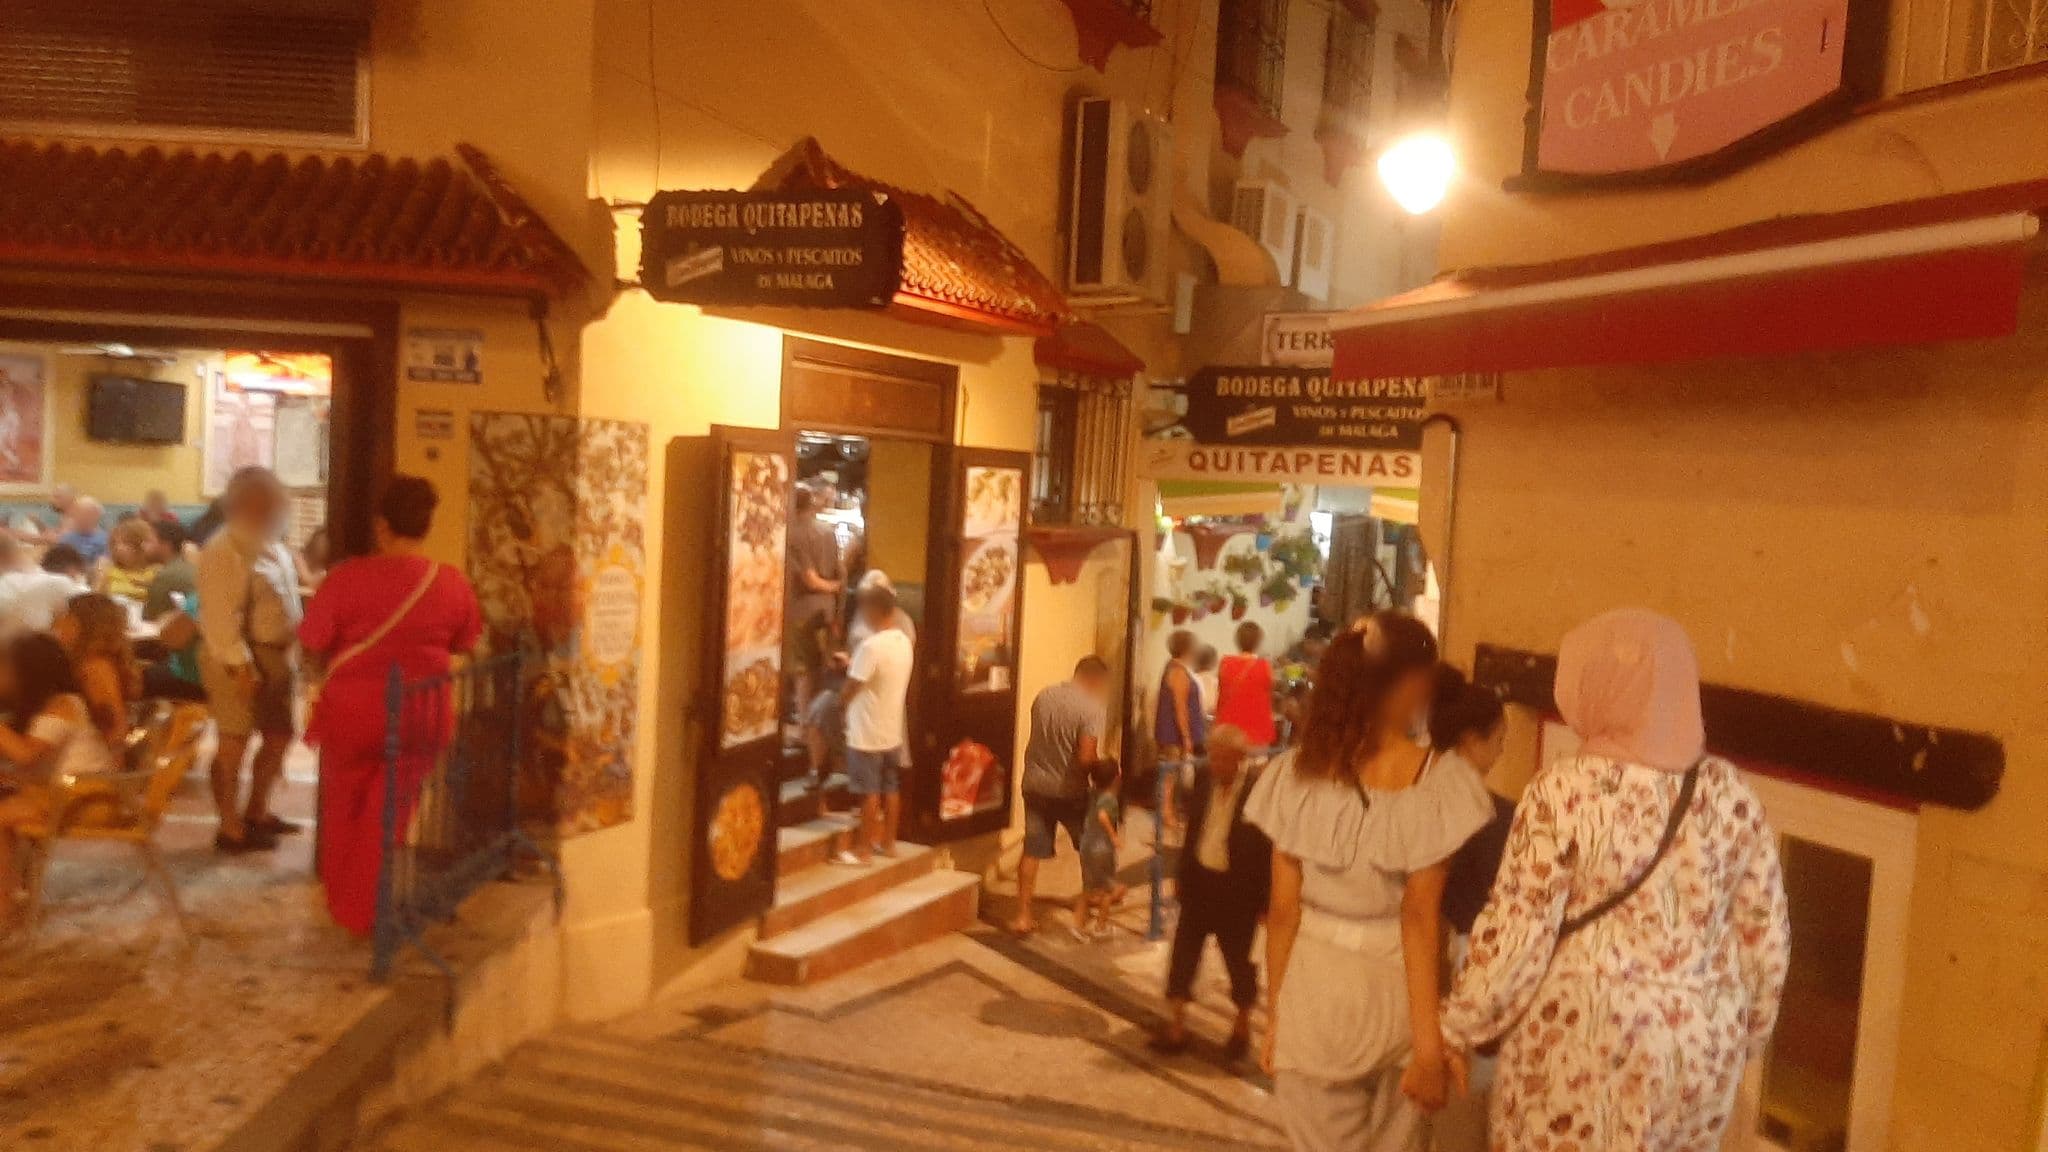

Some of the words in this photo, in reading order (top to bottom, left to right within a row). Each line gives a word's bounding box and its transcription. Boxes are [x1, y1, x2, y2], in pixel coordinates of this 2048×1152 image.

[1564, 27, 1783, 128] CANDIES
[666, 203, 738, 228] BODEGA
[743, 202, 863, 230] QUITAPENAS
[730, 247, 773, 266] VINOS
[1216, 376, 1301, 397] BODEGA
[1188, 450, 1414, 478] QUITAPENAS
